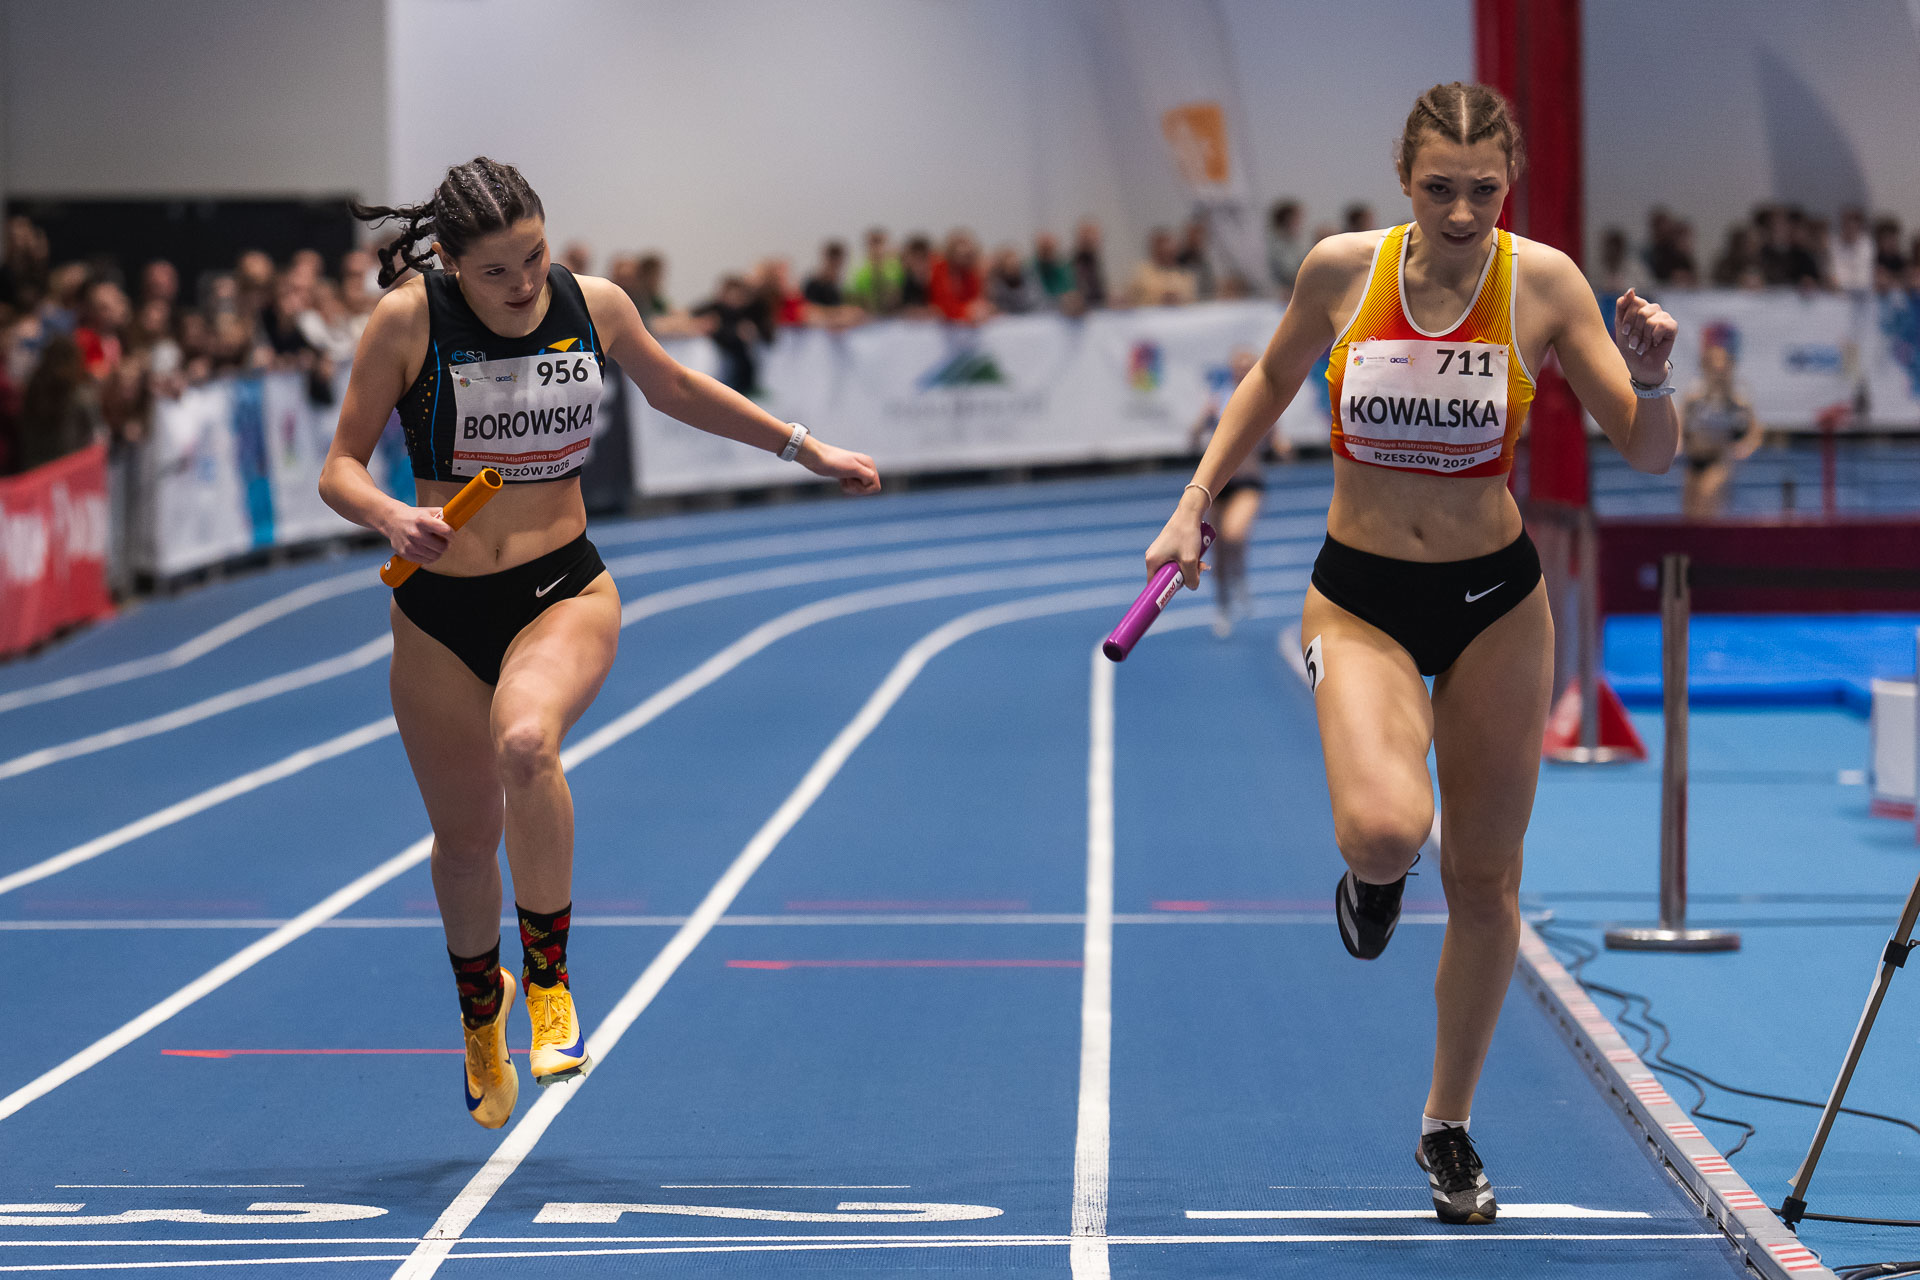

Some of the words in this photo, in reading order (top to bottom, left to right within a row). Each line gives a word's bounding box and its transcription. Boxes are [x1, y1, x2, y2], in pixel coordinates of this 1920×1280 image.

[453, 350, 484, 362] esa
[1437, 349, 1493, 377] 711
[537, 358, 589, 386] 956
[1350, 396, 1500, 428] KOWALSKA
[463, 403, 593, 440] BOROWSKA
[1367, 440, 1396, 448] Halowe
[1397, 442, 1444, 452] Mistrzostwa
[477, 453, 504, 461] Halowe
[505, 453, 547, 463] Mistrzostwa
[548, 450, 566, 459] Polski
[1374, 451, 1440, 466] RZESZÓW
[1442, 456, 1476, 469] 2026
[546, 459, 570, 475] 2026
